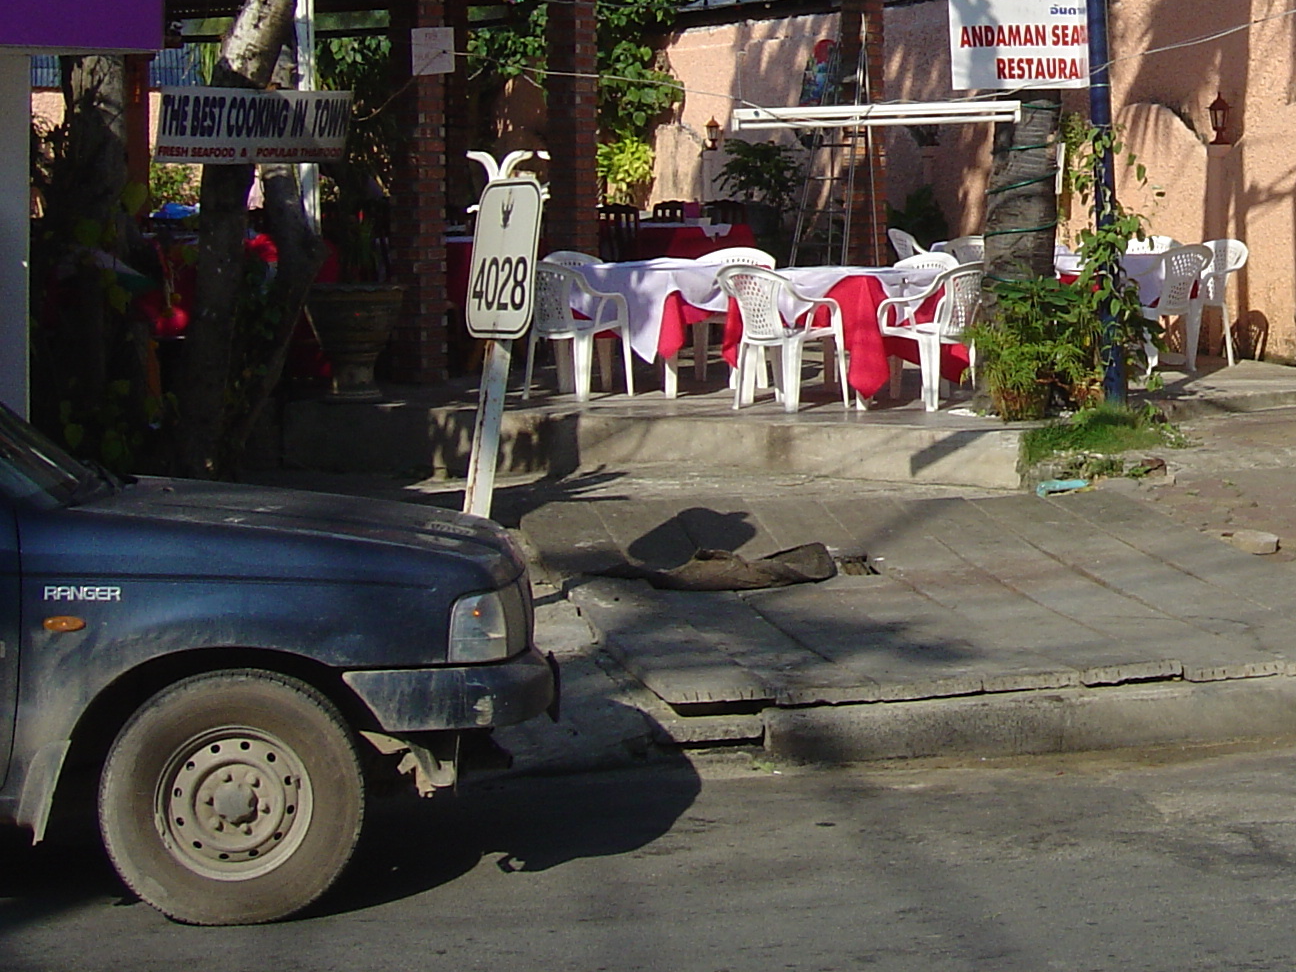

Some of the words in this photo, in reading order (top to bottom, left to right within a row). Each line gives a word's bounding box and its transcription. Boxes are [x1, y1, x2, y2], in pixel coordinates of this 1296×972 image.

[960, 24, 1047, 48] ANDAMAN
[162, 94, 188, 137] THE
[190, 95, 226, 138] BEST
[226, 96, 290, 138] COOKING
[290, 98, 309, 137] IN
[312, 98, 353, 138] TOWN
[157, 146, 188, 158] FRESH
[190, 146, 236, 158] SEAFOOD
[472, 256, 528, 312] 4028
[43, 585, 121, 602] RANGER
